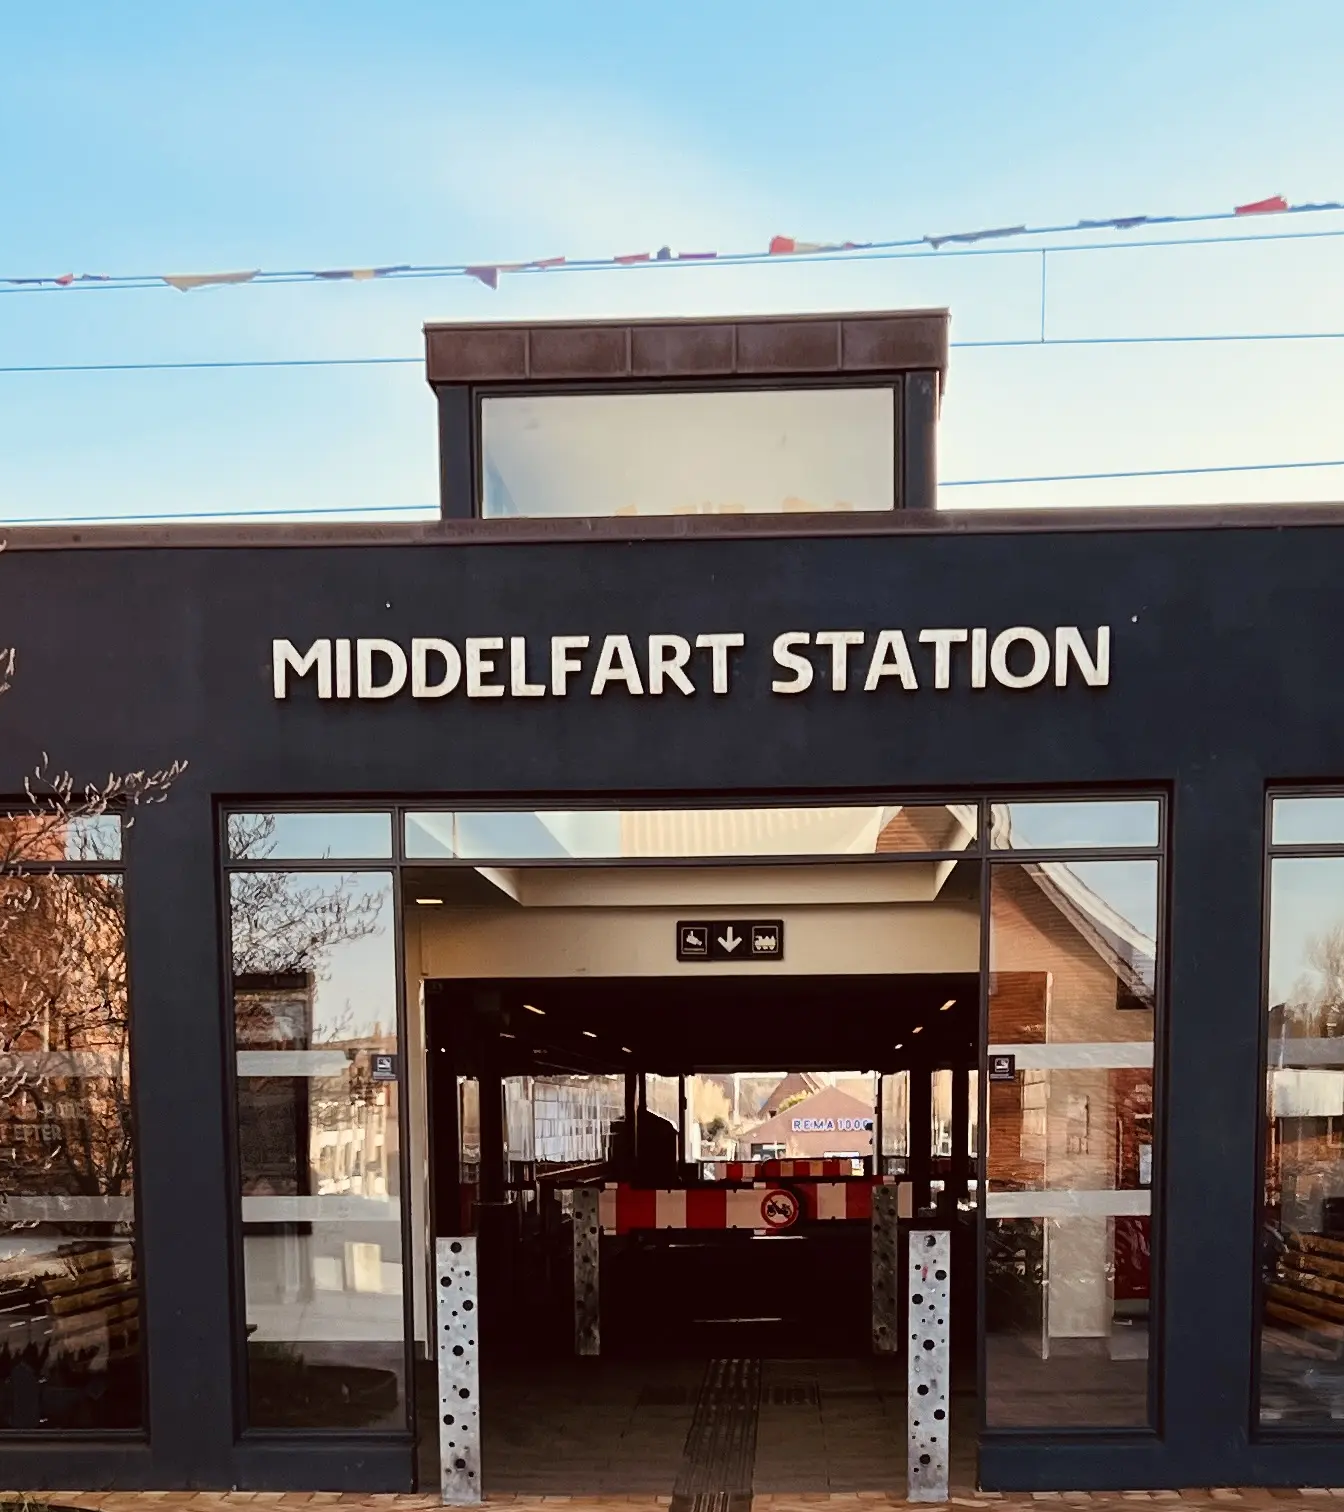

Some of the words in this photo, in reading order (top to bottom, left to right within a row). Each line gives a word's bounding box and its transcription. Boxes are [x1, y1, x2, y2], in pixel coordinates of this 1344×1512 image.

[272, 632, 745, 700] MIDDELFART
[772, 625, 1111, 693] STATION
[792, 1118, 836, 1131] REMA
